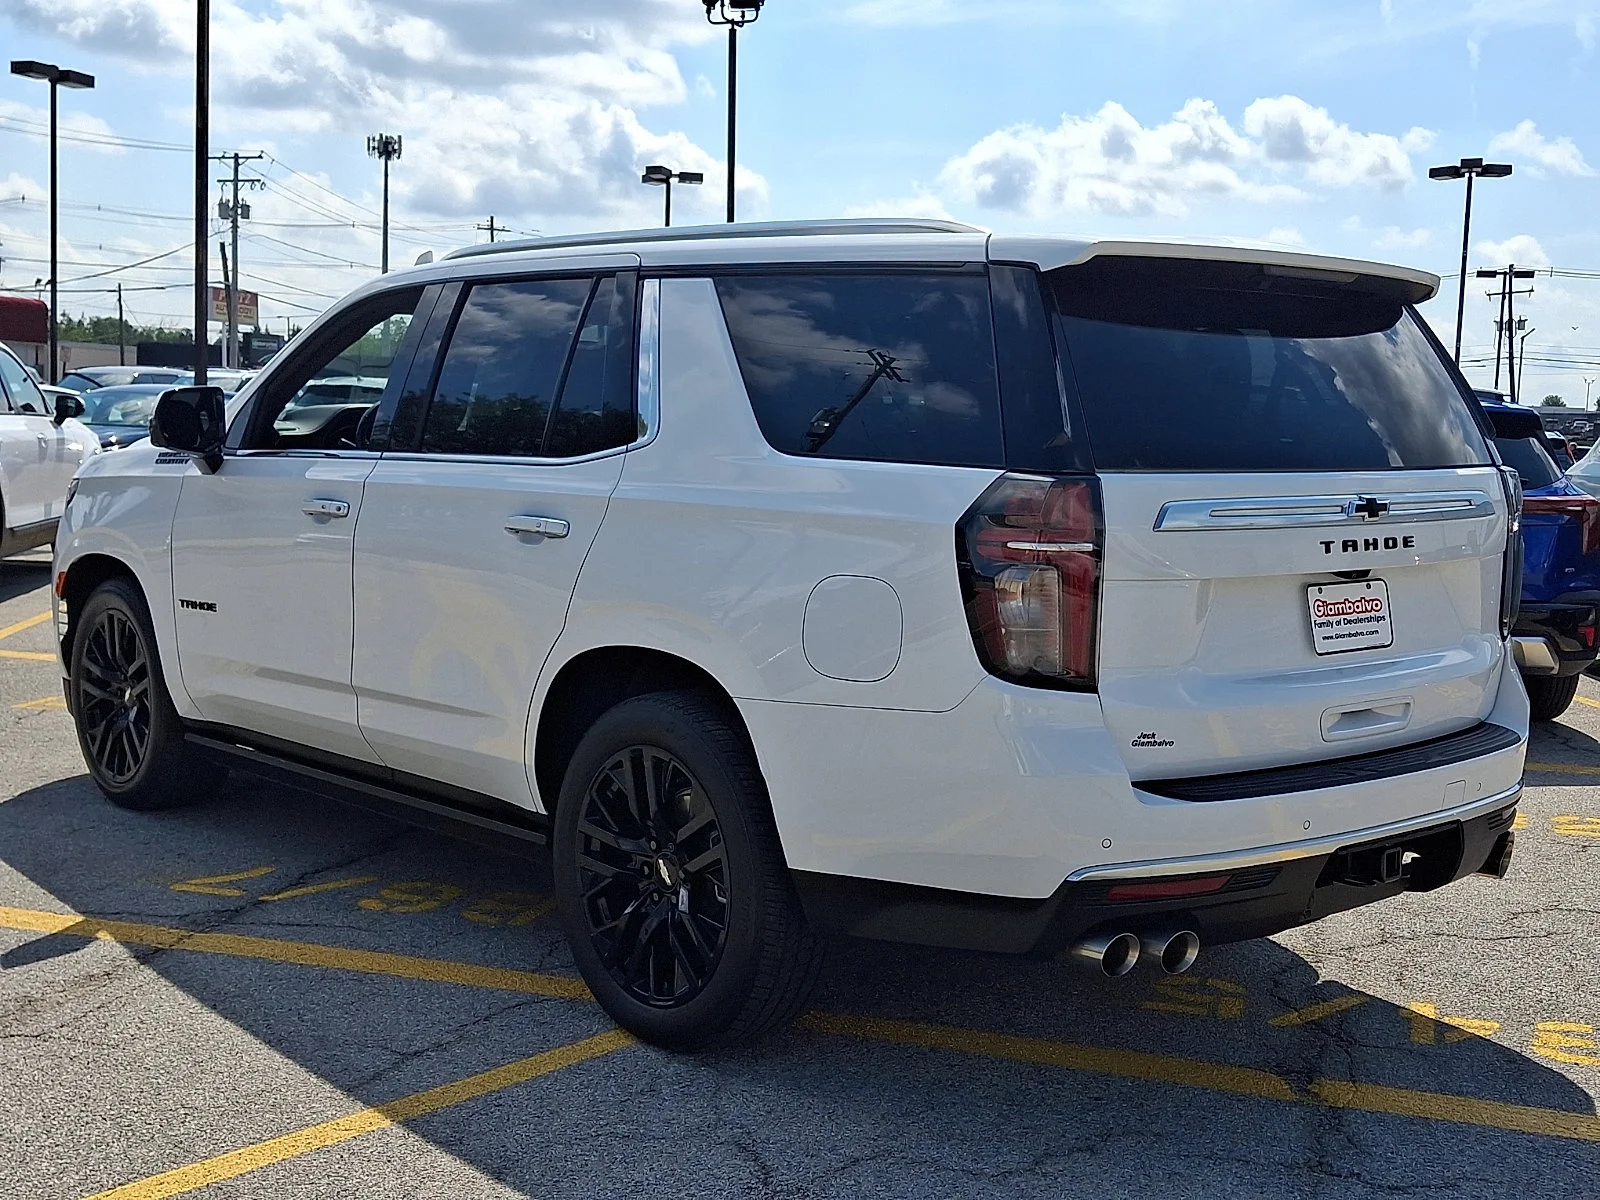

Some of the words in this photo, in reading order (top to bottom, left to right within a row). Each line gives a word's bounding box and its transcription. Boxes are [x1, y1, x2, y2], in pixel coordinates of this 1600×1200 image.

[1319, 535, 1415, 554] TAHOE
[178, 598, 218, 613] TAHOE
[1313, 597, 1382, 617] Giambalvo
[1313, 619, 1334, 630] Family
[1335, 618, 1342, 627] of
[1343, 614, 1386, 625] Dealerships
[1322, 630, 1379, 640] www.Giambalvo.com
[1131, 739, 1175, 747] Giambalvo
[1136, 731, 1157, 740] Jack
